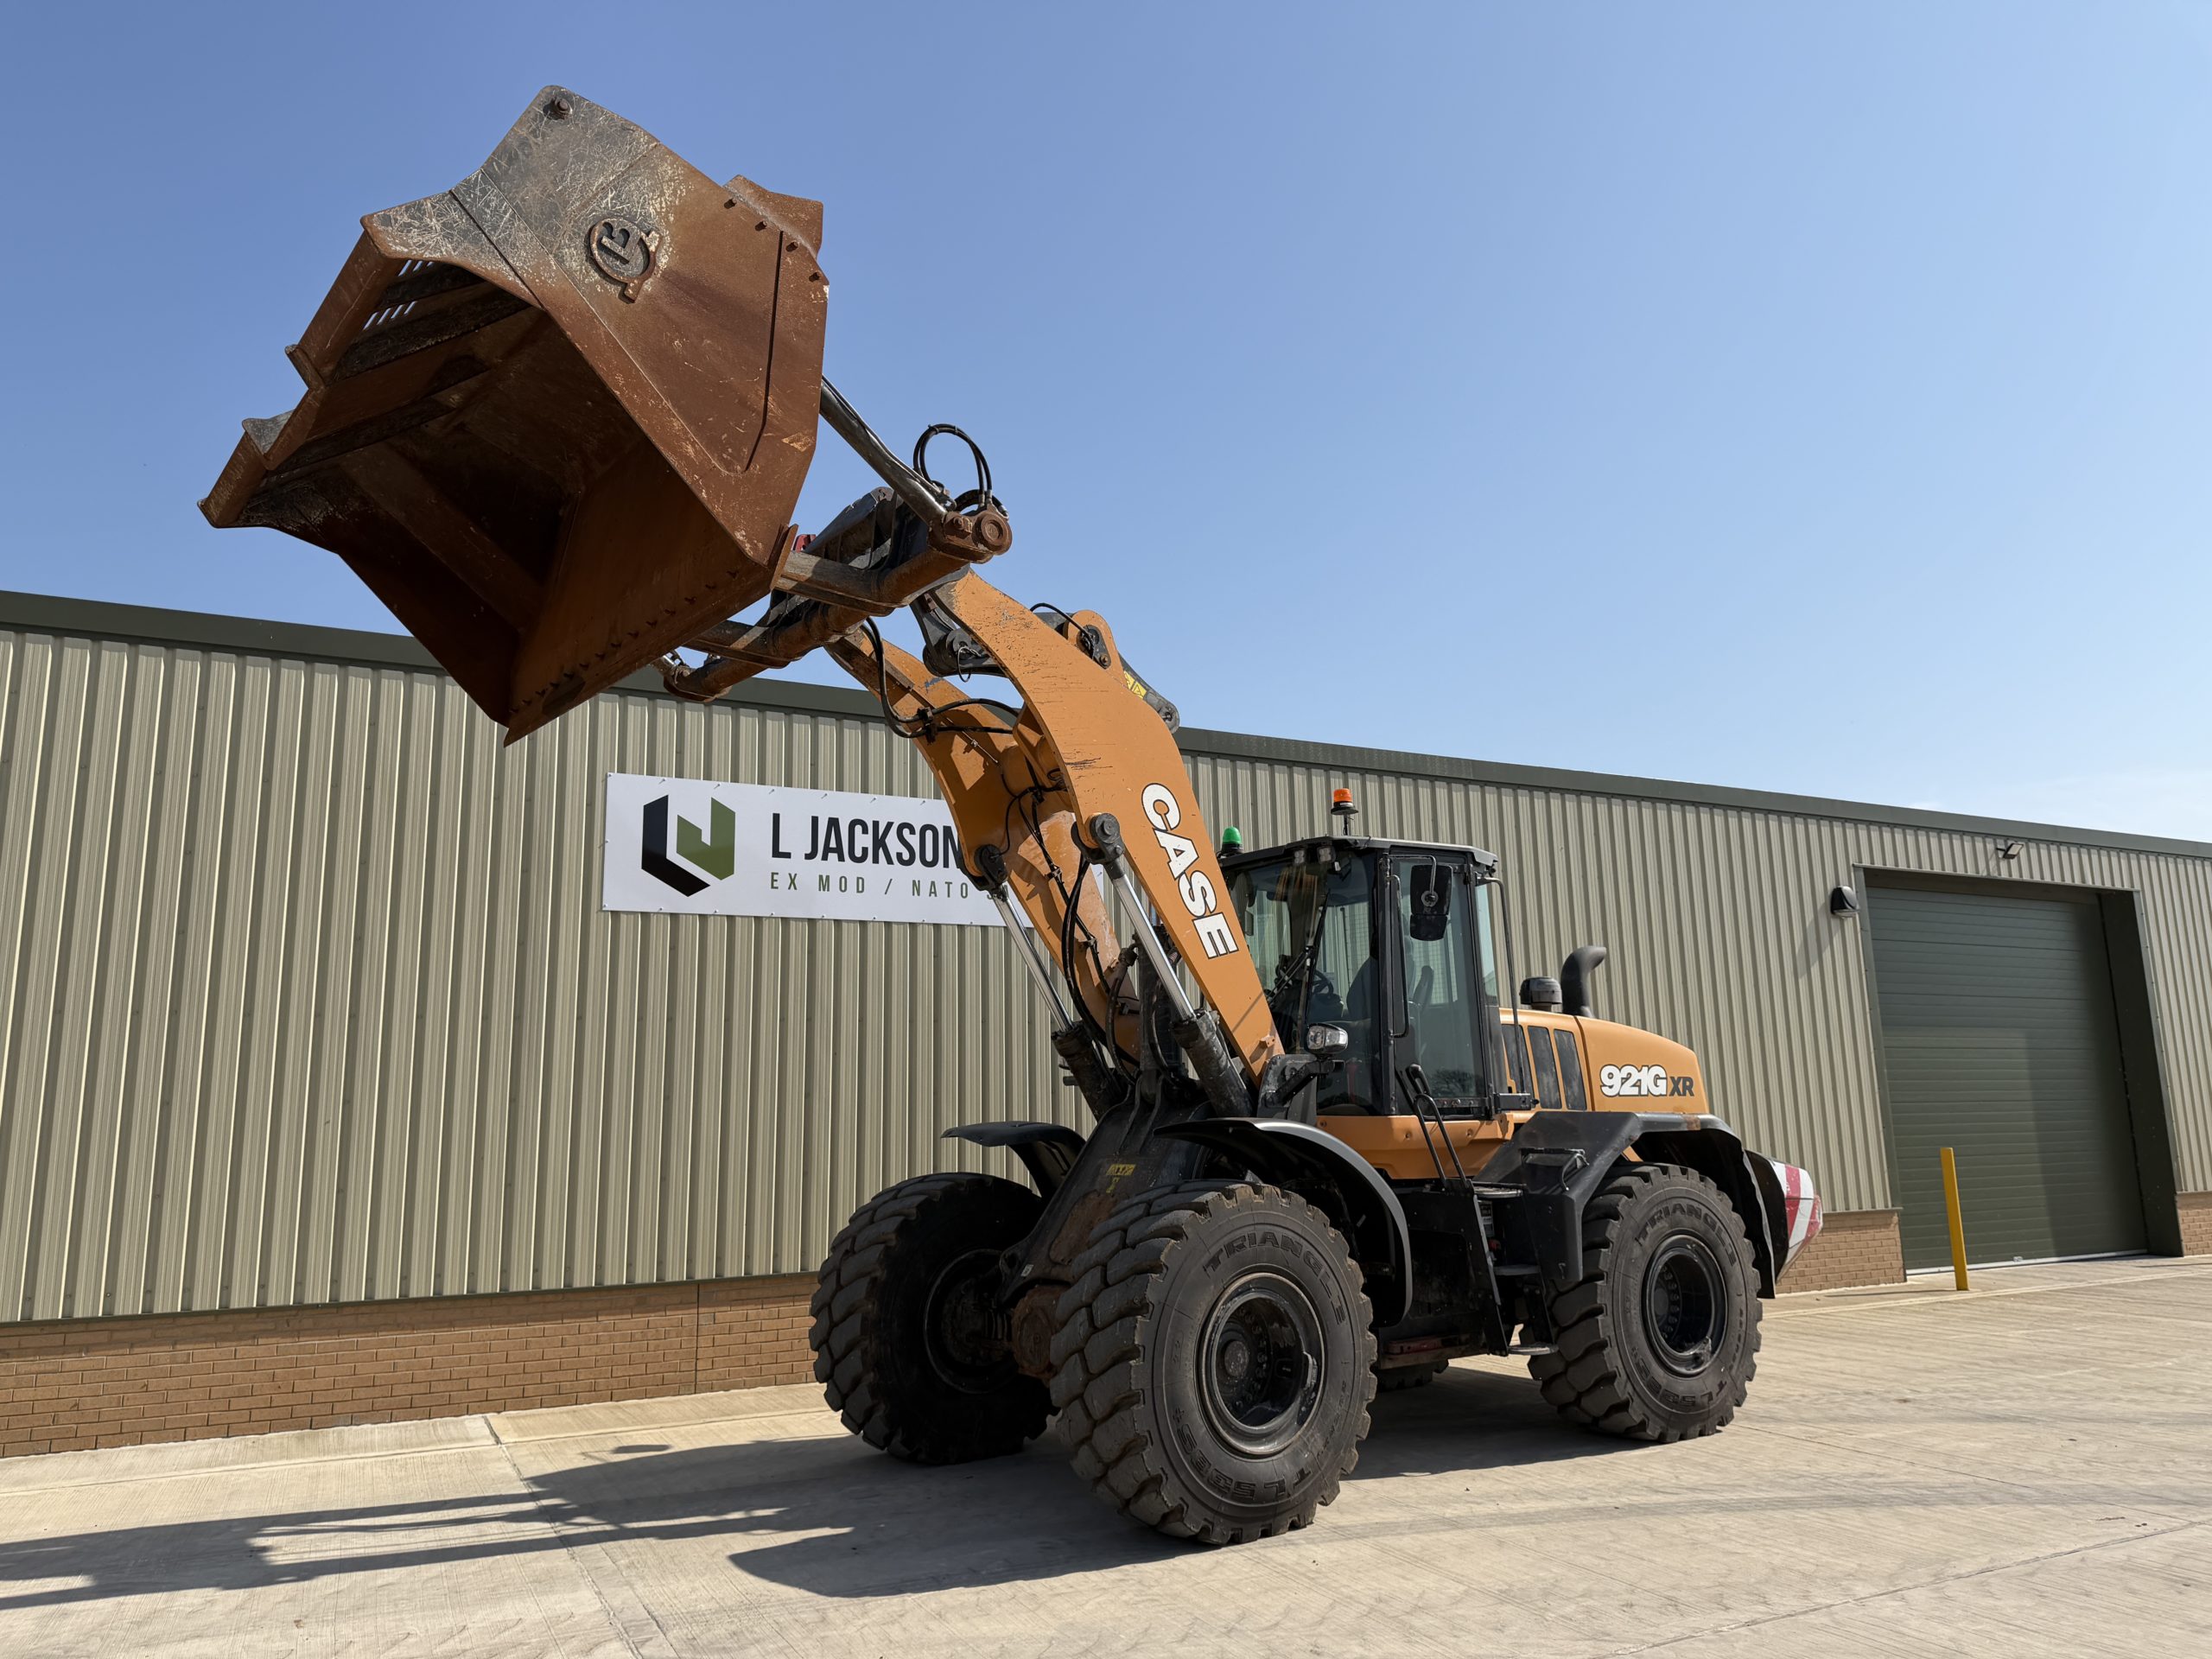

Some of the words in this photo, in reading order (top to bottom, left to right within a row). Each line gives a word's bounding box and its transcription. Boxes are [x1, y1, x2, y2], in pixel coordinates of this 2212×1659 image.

[771, 812, 791, 860] L
[804, 815, 963, 869] JACKSON
[771, 872, 798, 891] EX
[818, 874, 866, 893] MOD
[885, 878, 893, 895] /
[912, 880, 969, 899] NATO
[1141, 783, 1239, 959] CASE
[1599, 1064, 1668, 1097] 921G
[1669, 1076, 1694, 1096] XR
[1634, 1203, 1737, 1266] TRIANGLE
[1203, 1230, 1346, 1325] TRIANGLE
